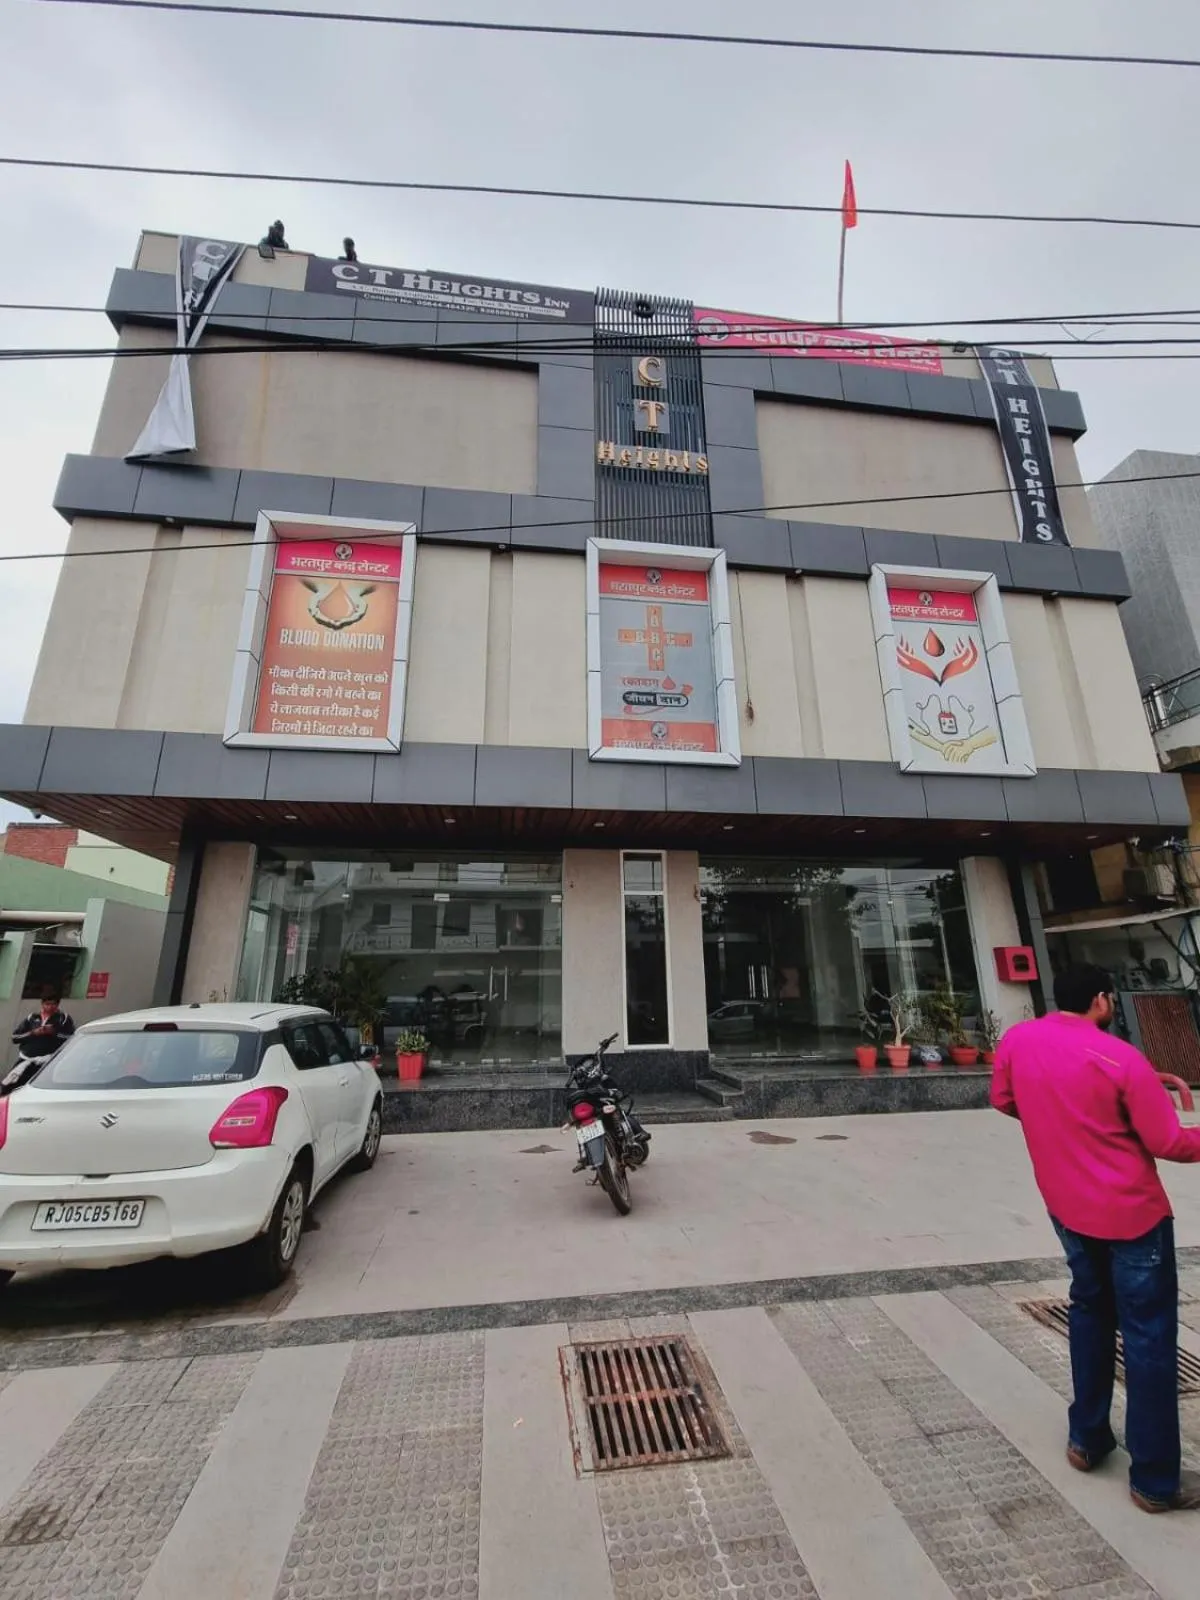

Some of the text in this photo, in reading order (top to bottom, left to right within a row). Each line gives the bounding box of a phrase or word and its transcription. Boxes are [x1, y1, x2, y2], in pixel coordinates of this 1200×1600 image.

[331, 264, 359, 280] C
[368, 268, 393, 285] T
[402, 273, 541, 304] HEIGHTS
[543, 296, 571, 309] INN
[637, 356, 662, 387] C
[638, 401, 665, 432] T
[597, 441, 708, 473] Heights
[1007, 397, 1054, 542] HEIGHTS
[290, 557, 332, 572] भरतपुर
[357, 560, 391, 574] सेन्टर
[280, 628, 385, 651] BLOOD DONATION
[327, 669, 352, 681] अपने
[271, 682, 298, 696] किसी
[299, 683, 315, 697] की
[367, 690, 382, 701] का
[359, 725, 373, 737] का
[45, 1204, 139, 1223] RJ05CB5168
